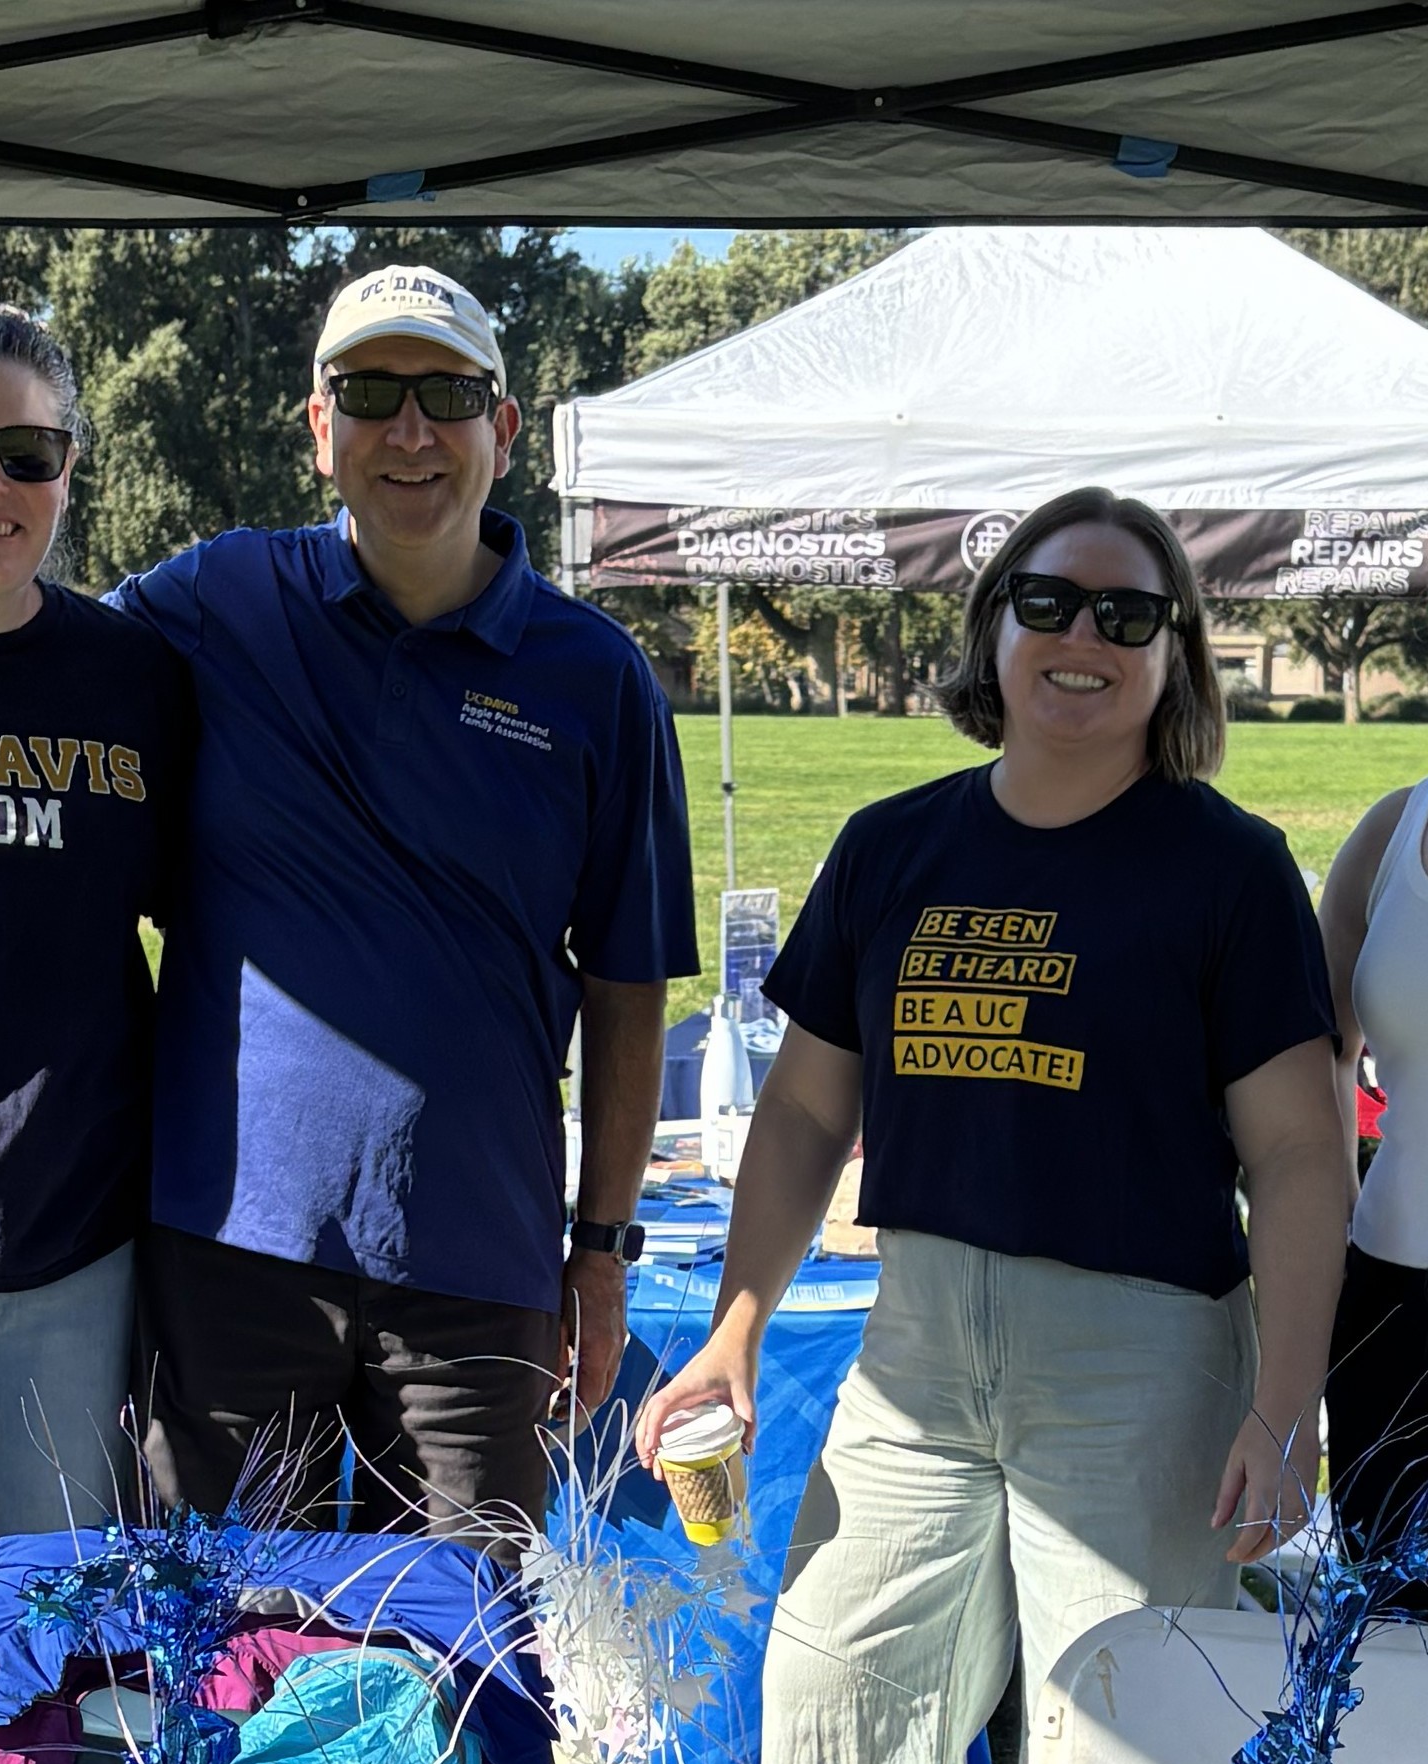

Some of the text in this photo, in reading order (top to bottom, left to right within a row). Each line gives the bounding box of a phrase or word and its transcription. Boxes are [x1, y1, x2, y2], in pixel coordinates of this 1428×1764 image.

[676, 531, 886, 557] DIAGNOSTICS
[1289, 538, 1424, 568] REPAIRS
[1274, 567, 1410, 595] REPAIRS
[459, 713, 553, 751] Family Association
[529, 723, 550, 738] and
[921, 912, 1048, 942] BE SEEN
[905, 951, 1066, 984] BE HEARD
[901, 997, 1019, 1028] BE A UC
[901, 1042, 1076, 1083] ADVOCATE!
